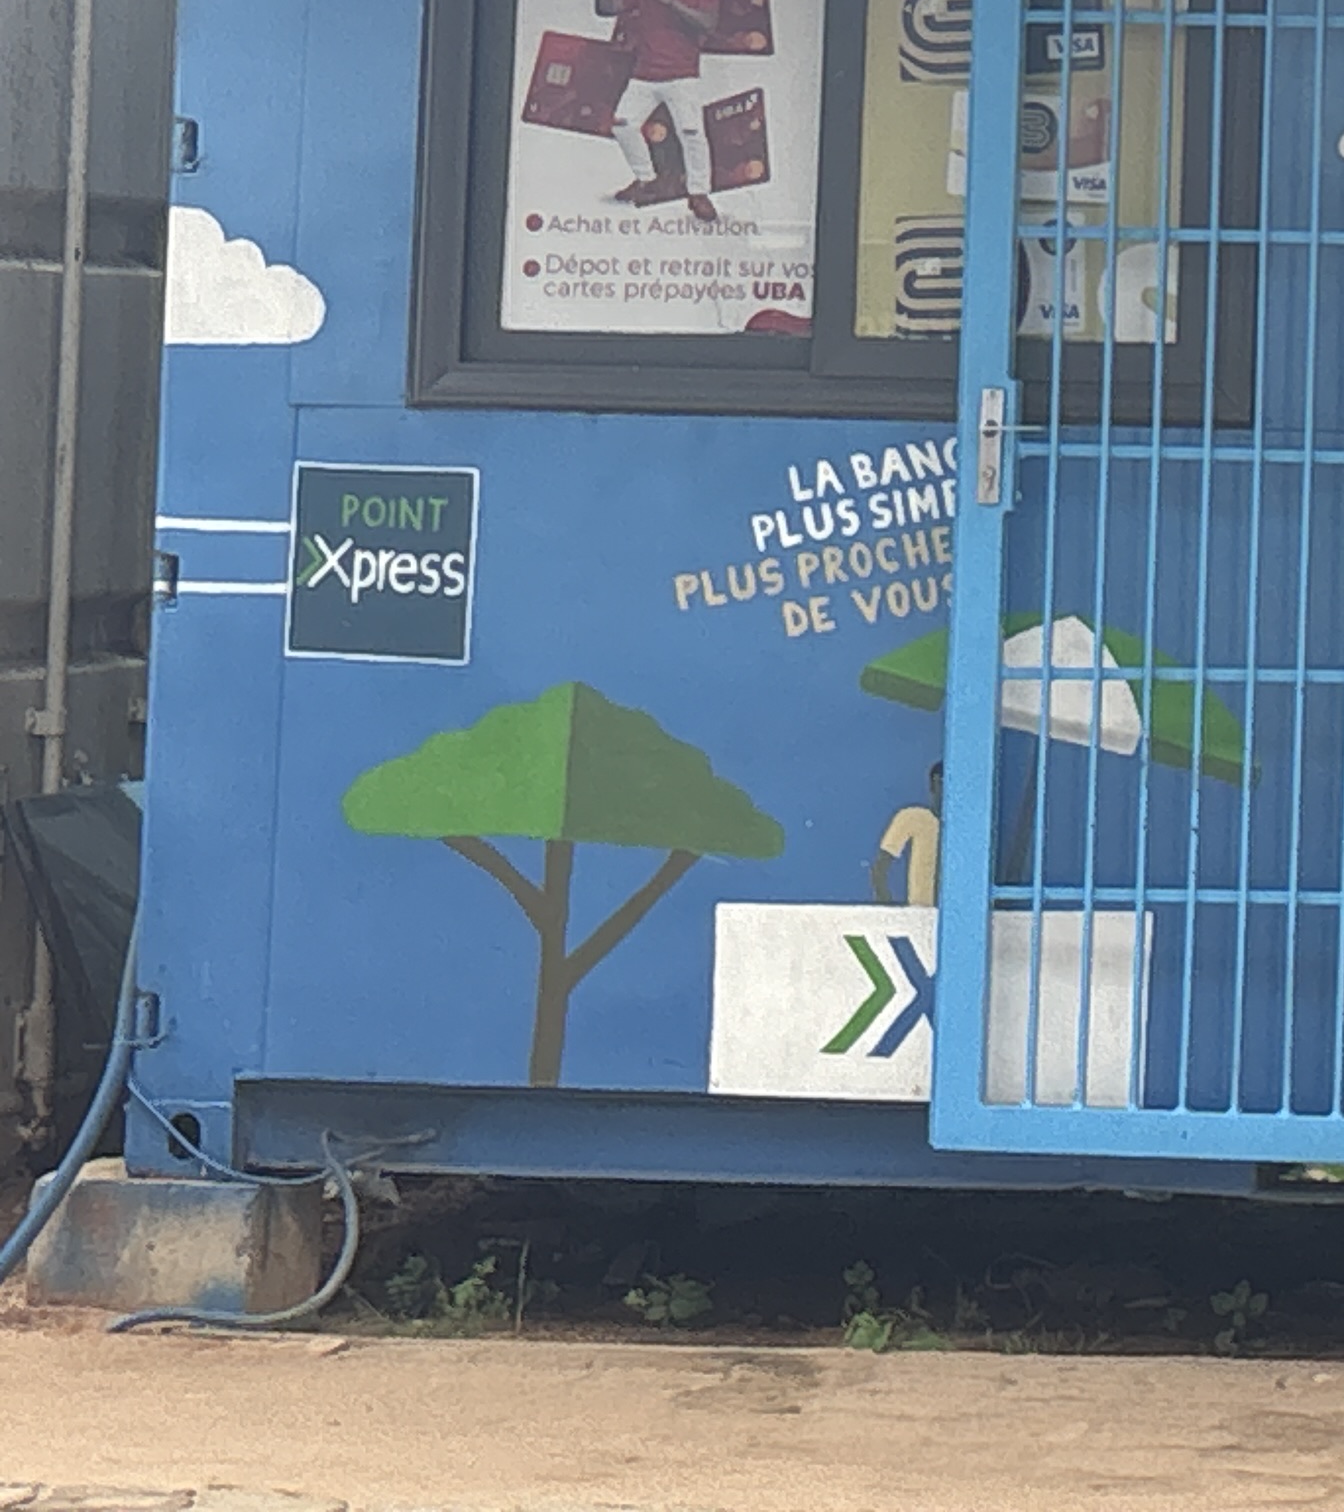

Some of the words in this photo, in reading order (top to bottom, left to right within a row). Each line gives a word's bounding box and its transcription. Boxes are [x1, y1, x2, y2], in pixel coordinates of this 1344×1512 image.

[1073, 177, 1107, 191] VISA
[547, 214, 612, 234] Achat
[618, 217, 641, 235] et
[649, 216, 758, 237] Activation
[545, 253, 619, 282] Dépot
[627, 256, 652, 277] et
[660, 256, 733, 278] retrait
[738, 261, 775, 278] sur
[543, 279, 616, 297] cartes
[752, 281, 807, 301] UBA
[787, 459, 846, 501] LA
[340, 494, 449, 533] POINT
[752, 498, 861, 552] PLUS
[306, 533, 466, 604] Xpress
[673, 557, 785, 611] PLUS
[796, 526, 953, 589] PROCHE
[782, 595, 836, 637] DE
